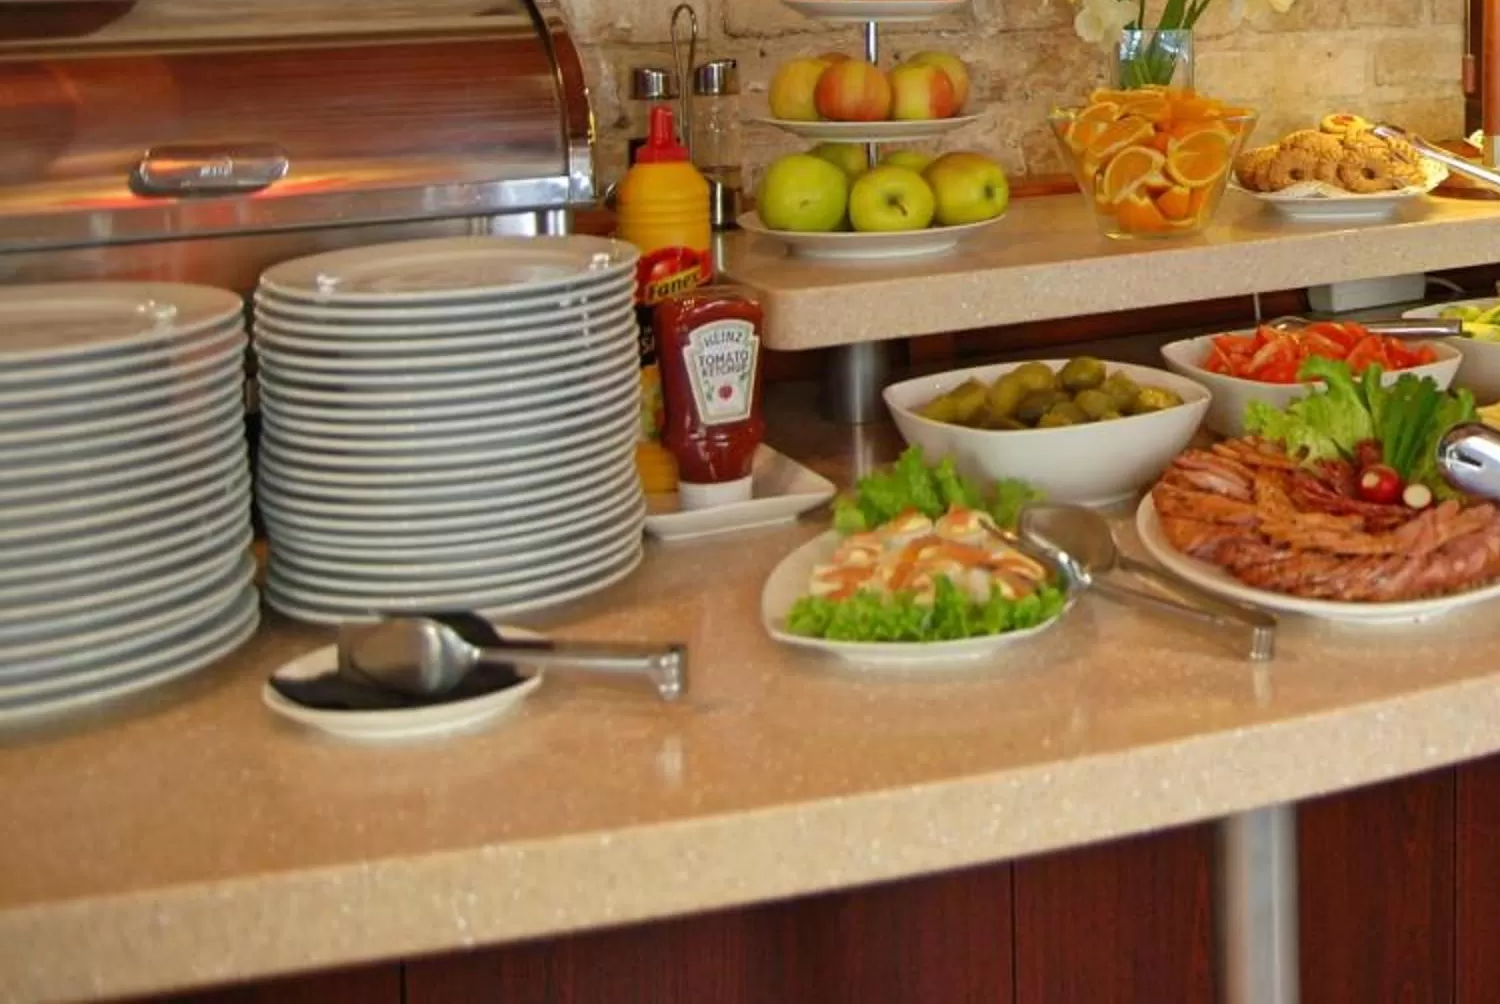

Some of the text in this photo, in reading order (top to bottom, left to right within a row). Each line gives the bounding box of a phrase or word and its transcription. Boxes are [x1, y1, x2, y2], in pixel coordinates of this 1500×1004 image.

[703, 331, 743, 348] HEINZ
[699, 350, 749, 367] TOMATO
[702, 361, 747, 377] KETCHUP
